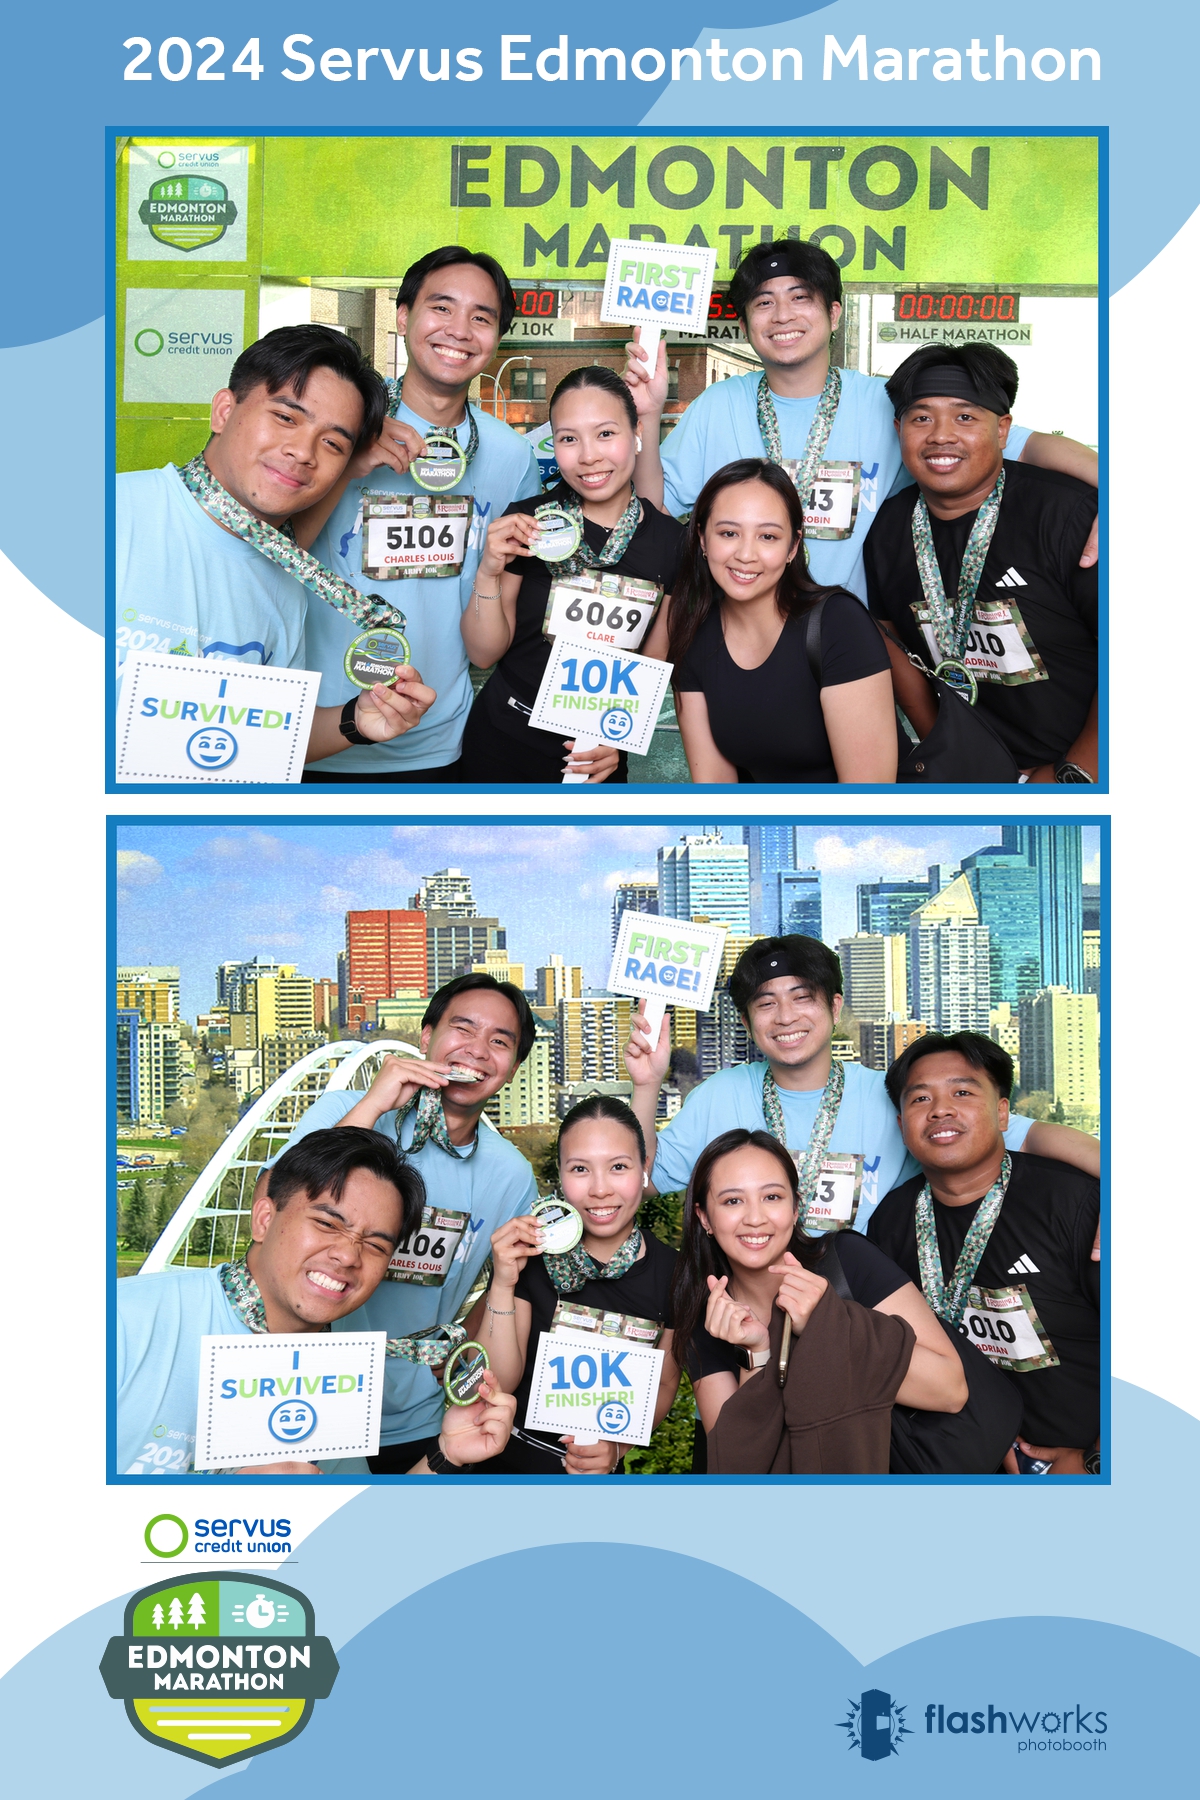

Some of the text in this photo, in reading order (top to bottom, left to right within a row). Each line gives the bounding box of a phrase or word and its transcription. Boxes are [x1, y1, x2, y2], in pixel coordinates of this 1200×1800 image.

[178, 152, 220, 161] servus
[450, 144, 990, 211] EDMONTON
[149, 203, 227, 214] EDMONTON
[619, 260, 700, 290] FIRST
[616, 286, 694, 315] RACE!
[168, 332, 233, 344] servus
[522, 322, 555, 336] 10K
[900, 328, 939, 340] HALF
[943, 328, 1030, 340] MARATHON
[168, 344, 232, 355] credit union
[807, 488, 834, 512] 43
[802, 516, 830, 524] ROBIN
[386, 525, 454, 550] 5106
[268, 540, 342, 598] ARMY 10K FINISHER
[384, 553, 454, 564] CHARLES LOUIS
[137, 612, 199, 638] servus credit
[565, 598, 642, 632] 6069
[116, 626, 171, 654] 2024
[586, 631, 616, 644] CLARE
[966, 630, 1006, 656] 010
[965, 658, 998, 668] ADRIAN
[218, 678, 228, 698] I
[560, 658, 640, 696] 10K
[140, 697, 292, 730] SURVIVED!
[552, 694, 640, 714] FINISHER!
[628, 932, 710, 968] FIRST
[624, 958, 702, 992] RACE!
[808, 1207, 832, 1216] OBIN
[398, 1234, 446, 1259] 106
[390, 1258, 442, 1272] ARLES LOUIS
[292, 1350, 300, 1370] I
[976, 1344, 1008, 1355] ADRIAN
[548, 1352, 632, 1390] 10K
[220, 1374, 364, 1400] SURVIVED!
[545, 1390, 634, 1408] FINISHER!
[136, 1442, 192, 1472] 2024
